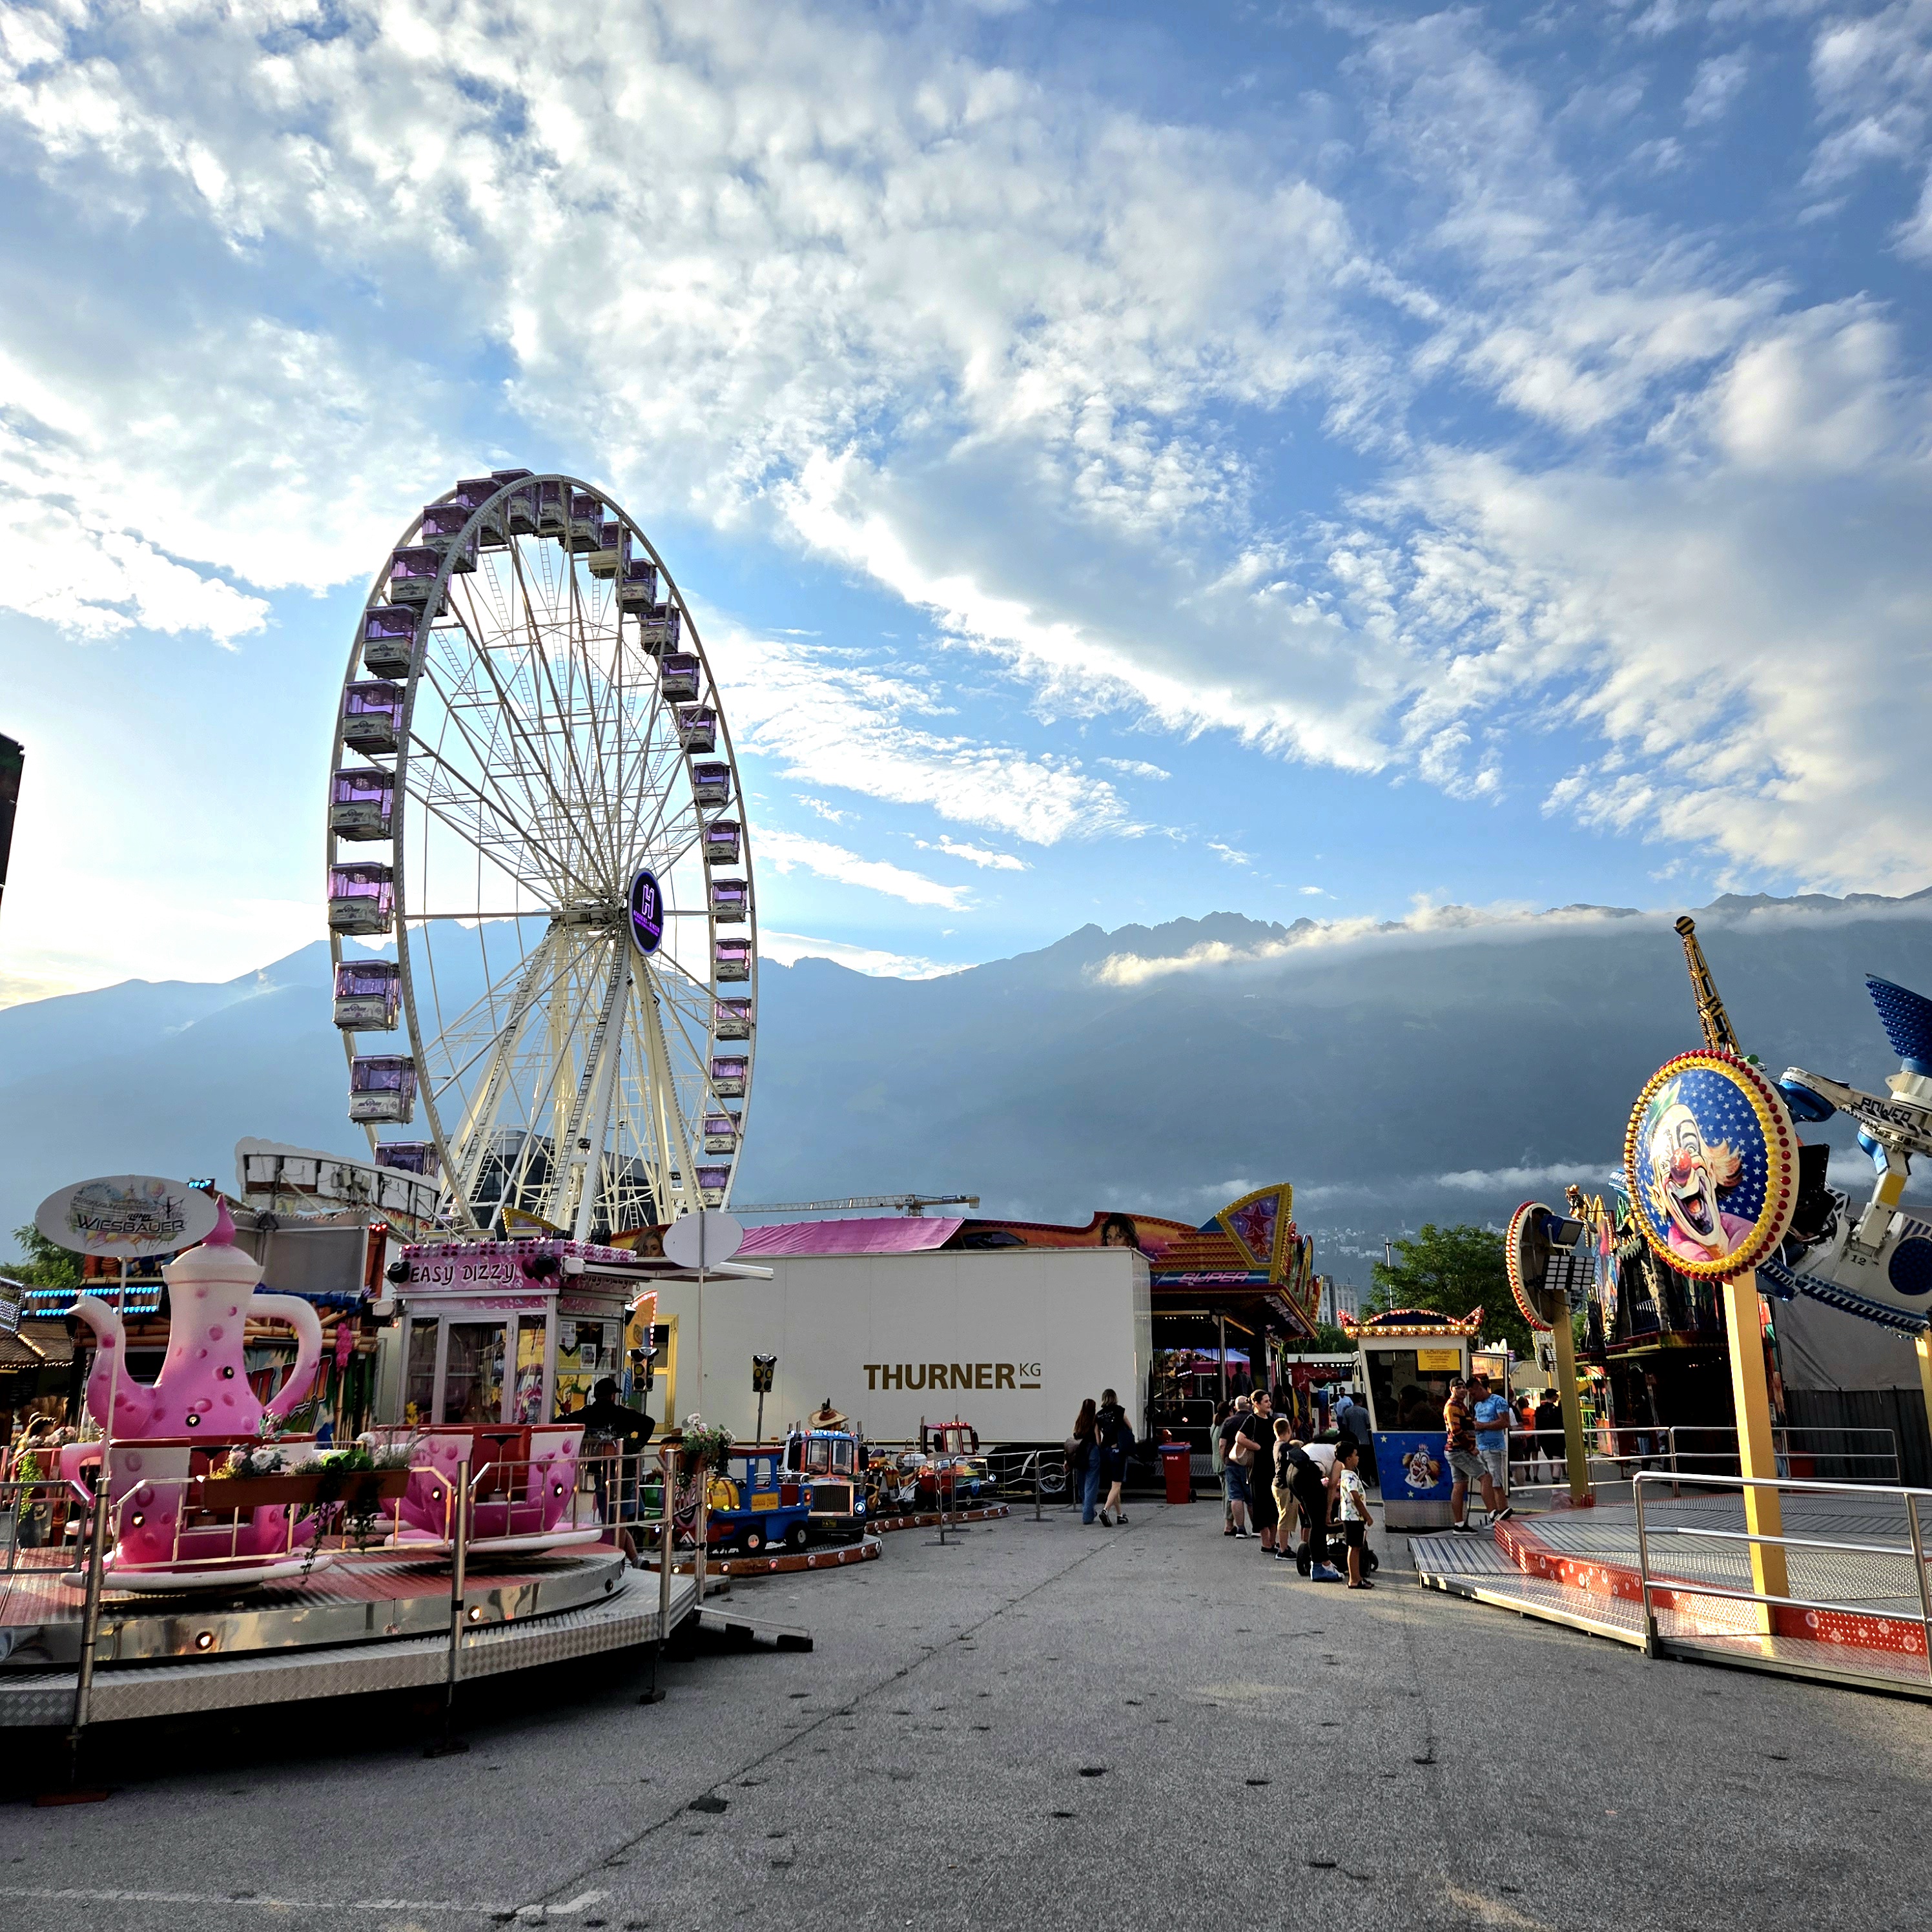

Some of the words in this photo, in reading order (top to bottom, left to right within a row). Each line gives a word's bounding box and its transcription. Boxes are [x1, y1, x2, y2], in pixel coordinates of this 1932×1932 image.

[77, 1213, 185, 1231] WIESBAUER
[1850, 1255, 1867, 1266] 12
[410, 1265, 455, 1286] EASY
[462, 1262, 515, 1284] DIZZY
[863, 1363, 1016, 1390] THURNER
[1020, 1362, 1041, 1377] KG
